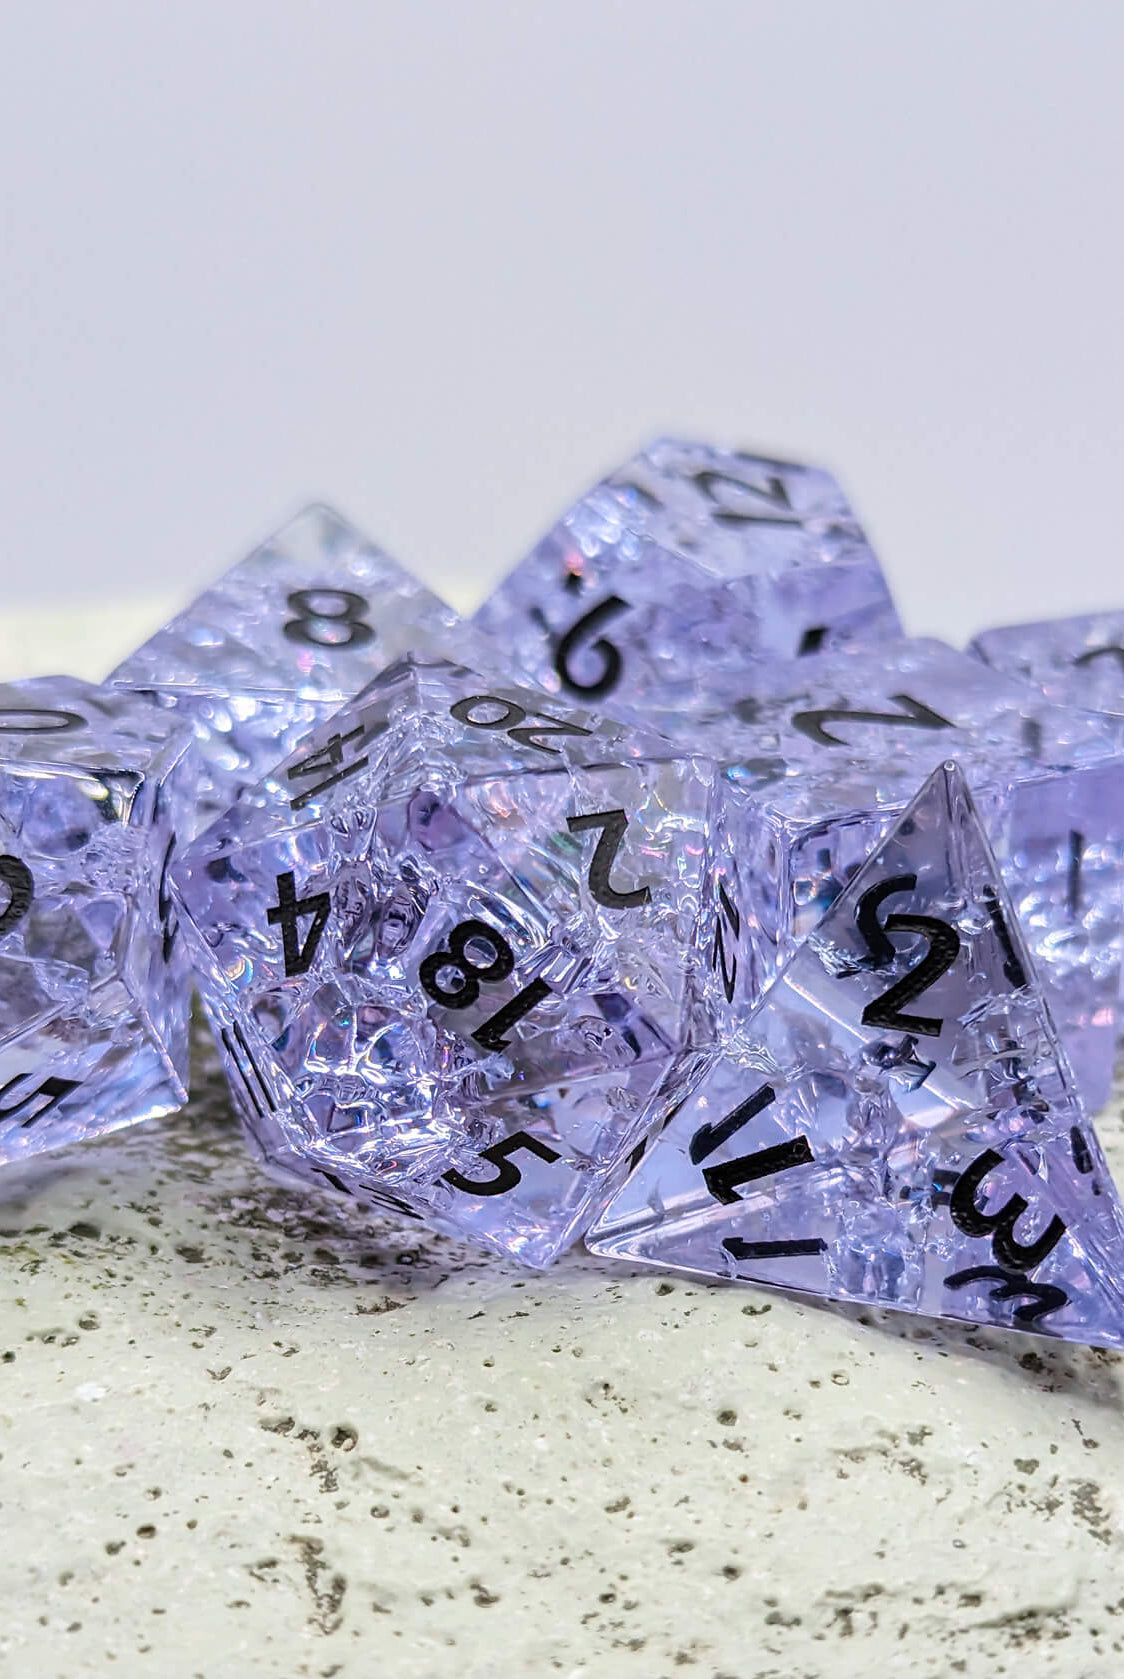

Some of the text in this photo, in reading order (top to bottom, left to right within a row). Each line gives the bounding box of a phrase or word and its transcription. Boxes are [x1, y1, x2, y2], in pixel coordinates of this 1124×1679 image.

[283, 588, 376, 648] 8
[288, 722, 370, 810] 14
[449, 695, 595, 753] 20
[567, 808, 652, 910] 2
[266, 870, 330, 977] 4
[419, 918, 553, 1053] 18
[861, 913, 960, 1037] 2
[440, 1130, 561, 1198] 5
[702, 1134, 816, 1206] 1
[950, 1148, 1067, 1274] 3
